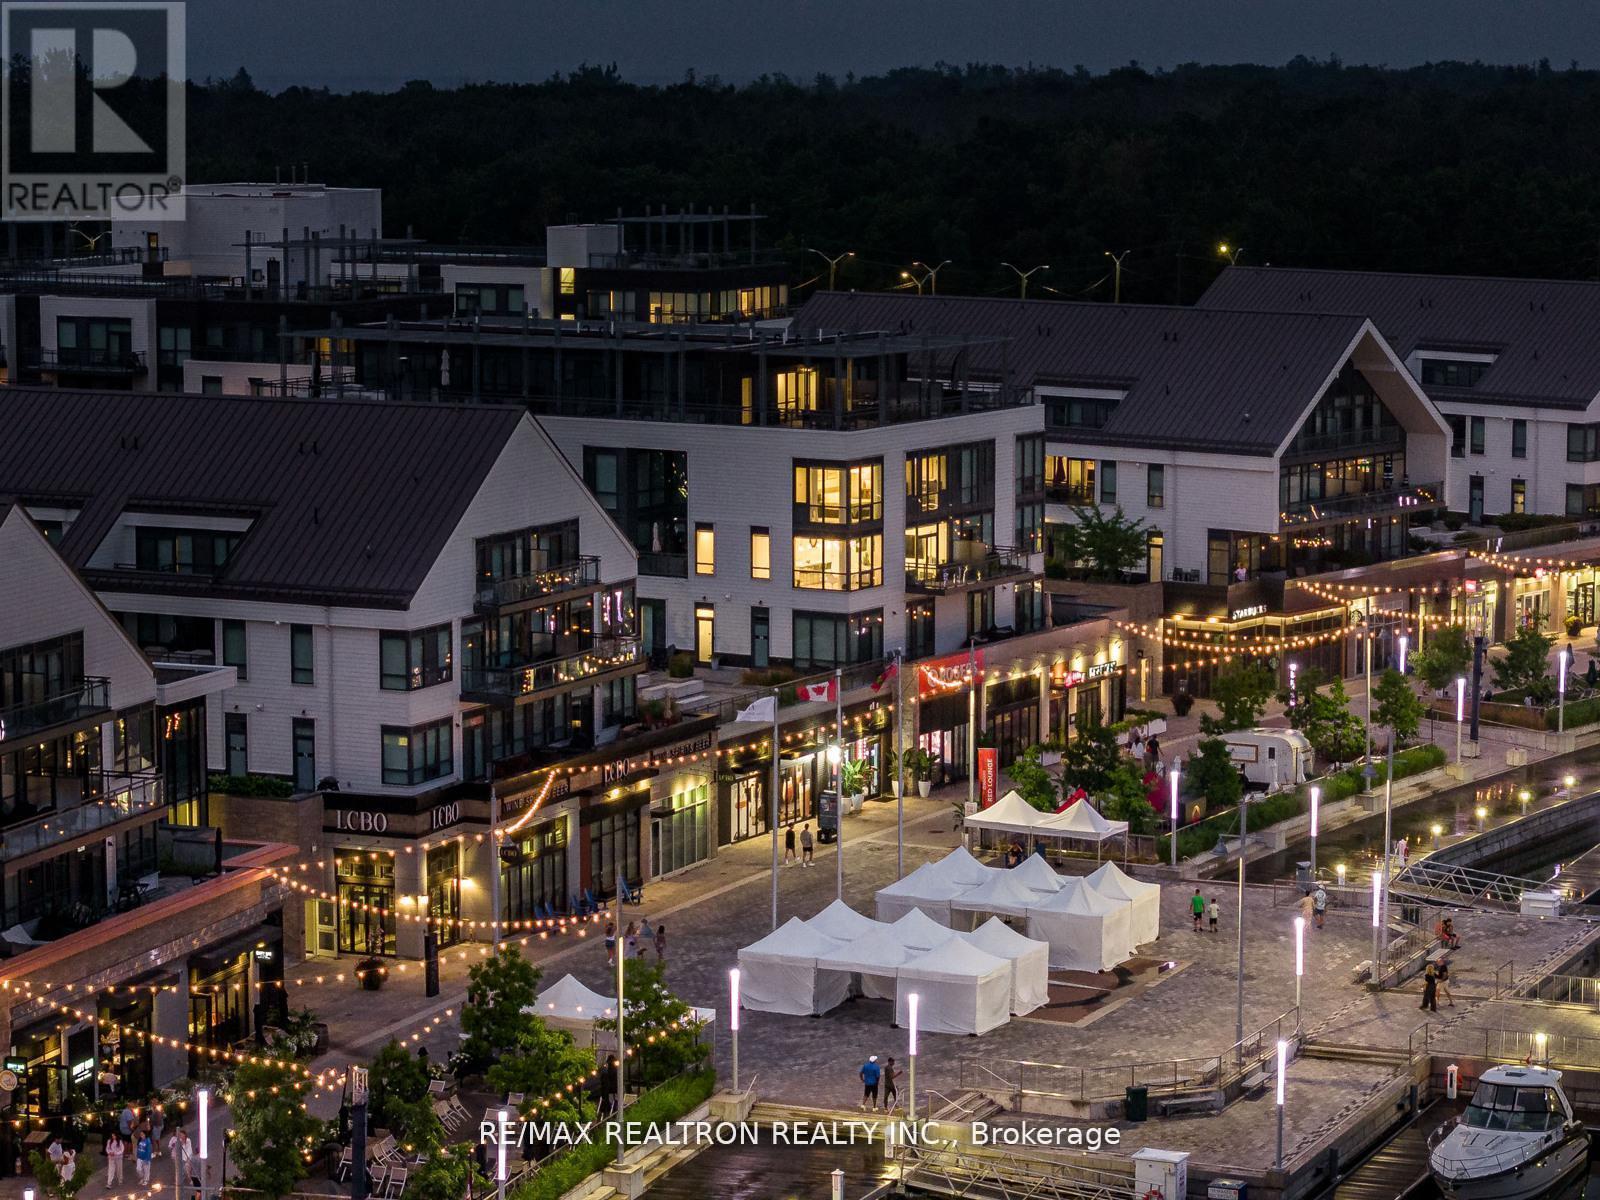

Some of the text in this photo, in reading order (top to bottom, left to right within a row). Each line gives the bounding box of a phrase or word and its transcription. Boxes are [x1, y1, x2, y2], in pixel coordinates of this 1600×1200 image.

[604, 758, 630, 783] LCBO
[336, 809, 388, 833] LCBO
[433, 801, 459, 829] LCBO
